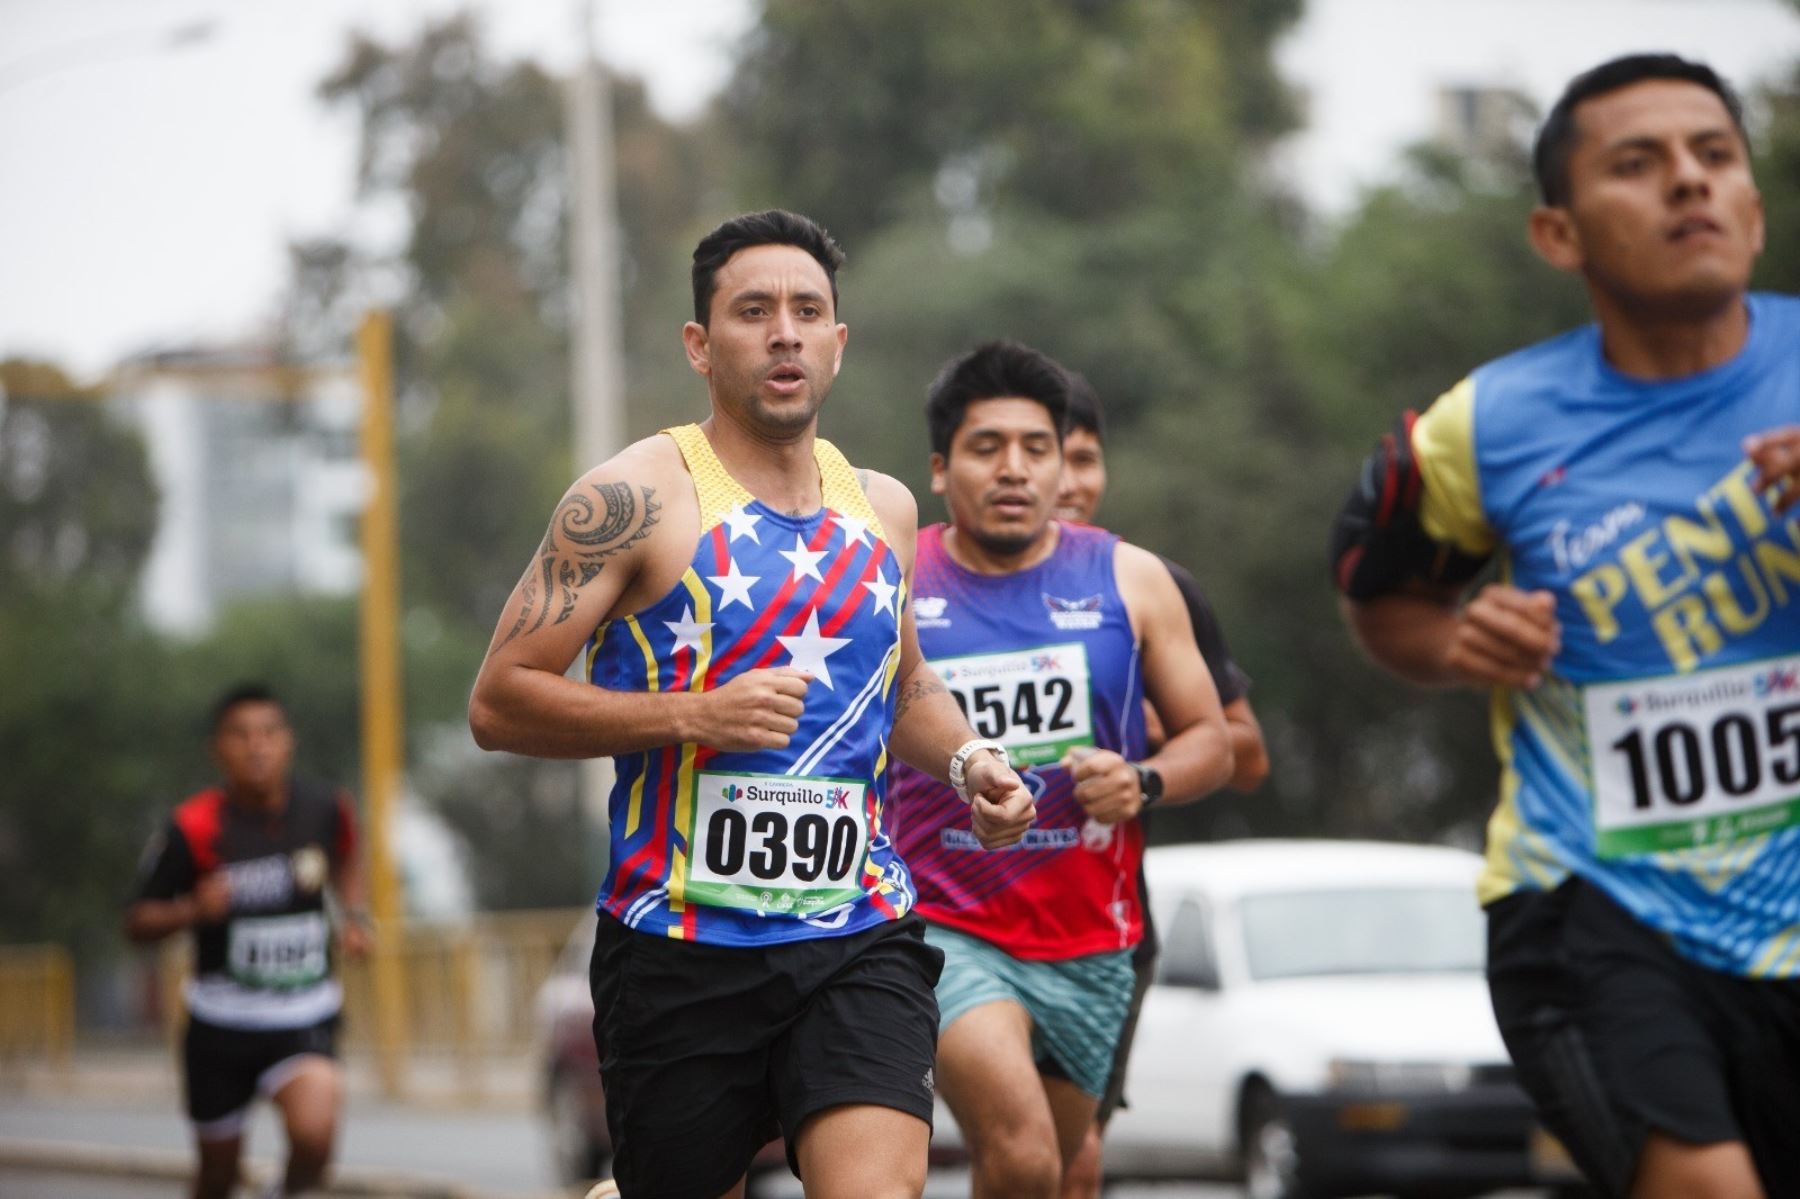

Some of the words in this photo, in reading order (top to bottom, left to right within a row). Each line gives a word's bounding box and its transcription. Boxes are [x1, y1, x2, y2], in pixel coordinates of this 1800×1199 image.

[1547, 502, 1646, 575] Team
[1571, 460, 1793, 643] PENT
[1611, 701, 1800, 811] 1005
[746, 786, 824, 806] Surquillo
[705, 808, 858, 882] 0390
